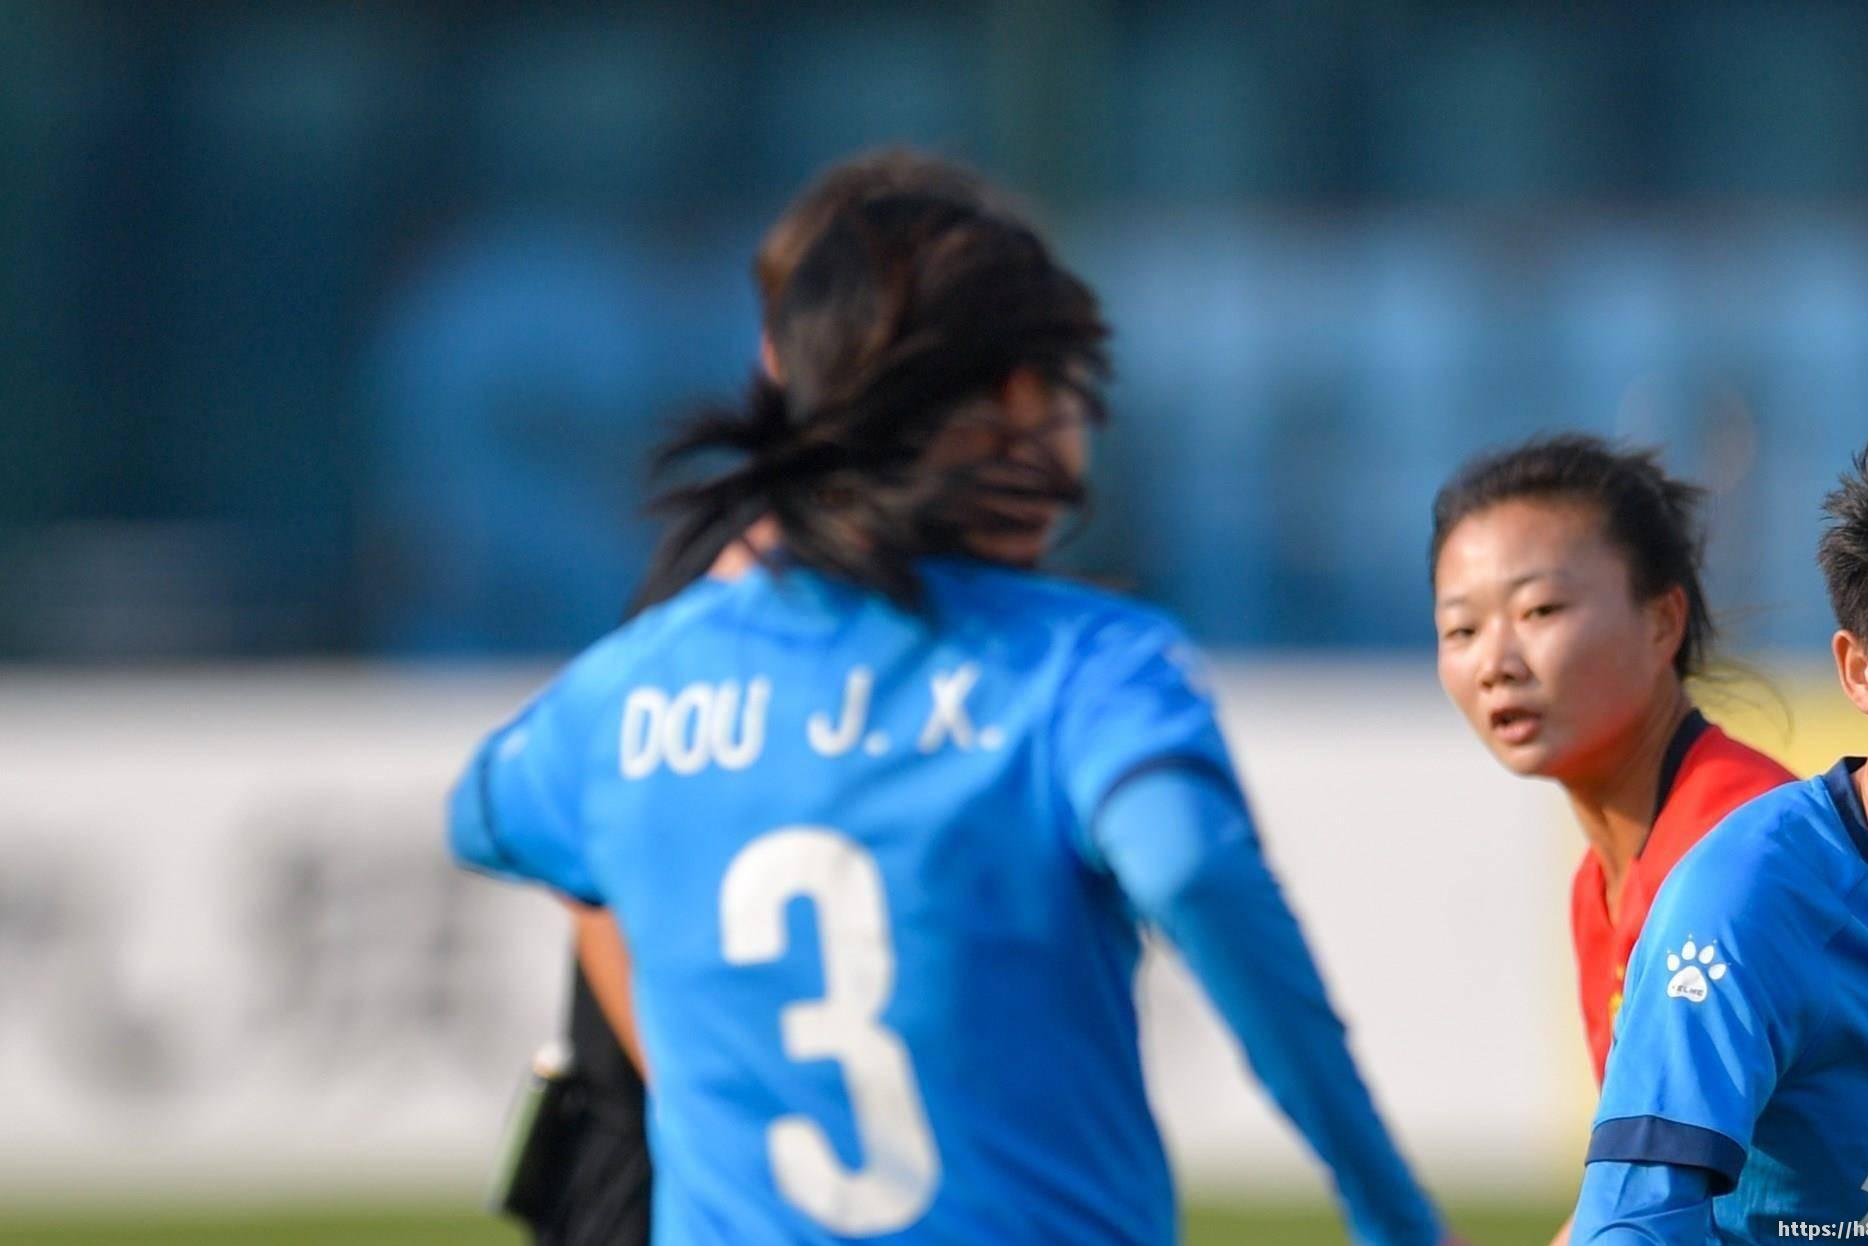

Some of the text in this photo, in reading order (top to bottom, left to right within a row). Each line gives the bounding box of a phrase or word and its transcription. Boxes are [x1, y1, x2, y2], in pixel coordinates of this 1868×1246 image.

[621, 662, 1005, 779] DOU J. X.
[720, 825, 942, 1237] 3
[1671, 984, 1705, 997] ELME
